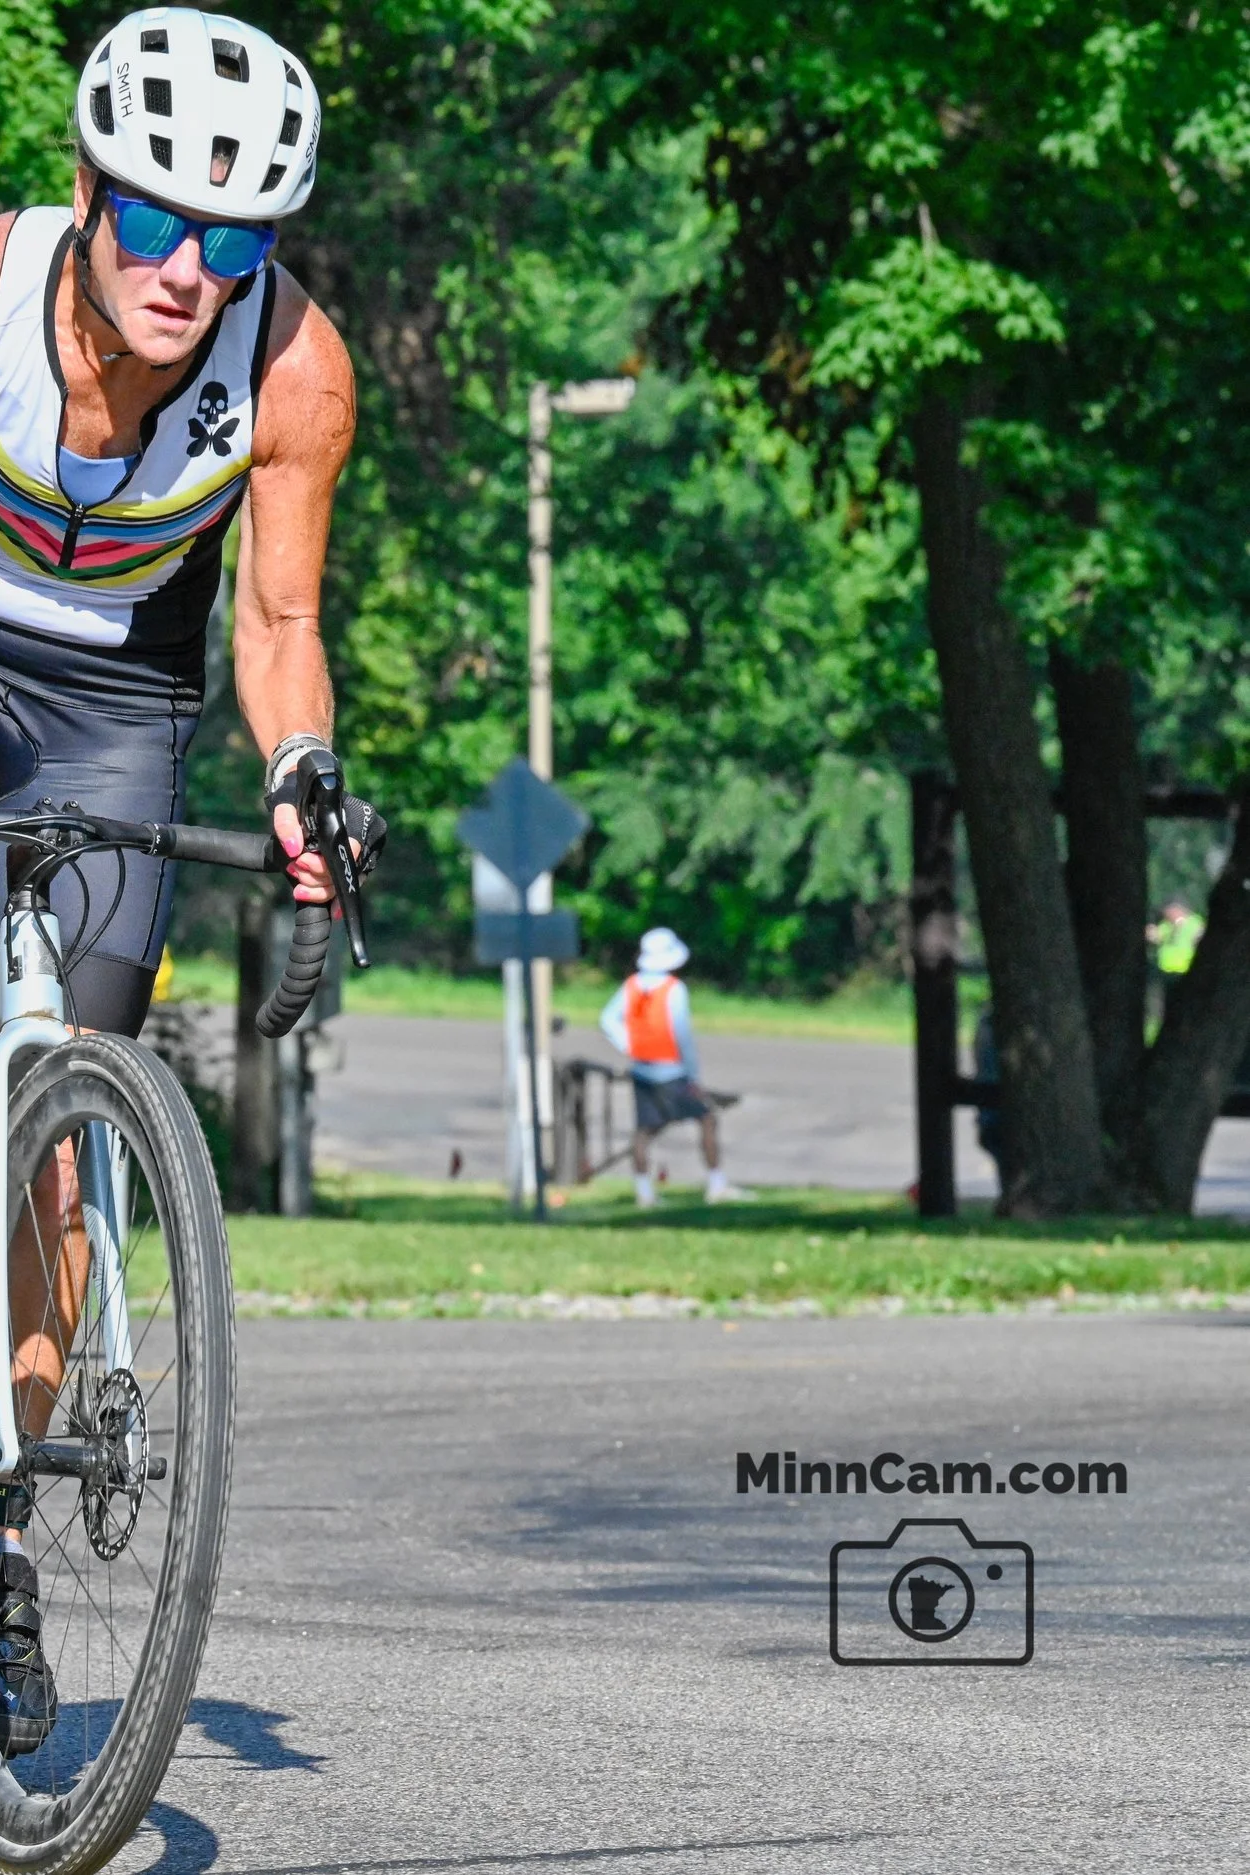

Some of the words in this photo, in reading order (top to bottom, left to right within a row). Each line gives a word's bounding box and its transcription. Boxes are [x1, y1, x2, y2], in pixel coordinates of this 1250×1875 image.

[117, 62, 134, 118] SMITH
[361, 805, 373, 840] GIRO
[338, 844, 356, 893] GRX
